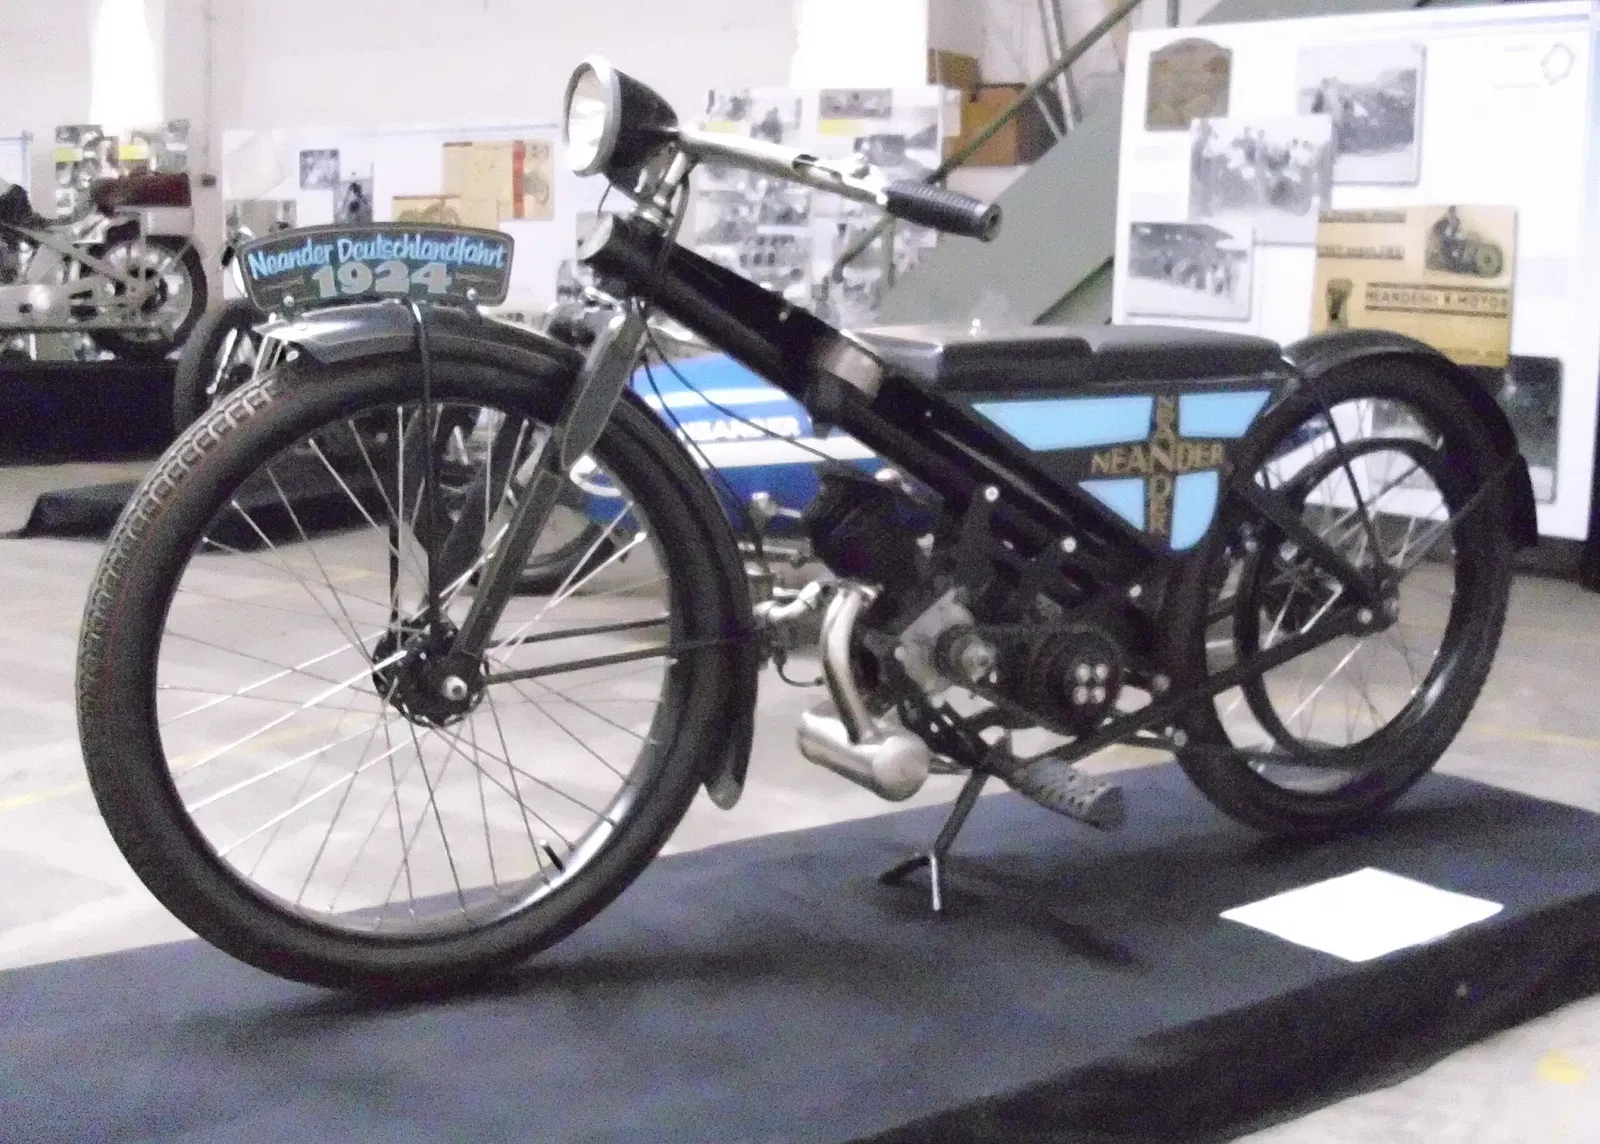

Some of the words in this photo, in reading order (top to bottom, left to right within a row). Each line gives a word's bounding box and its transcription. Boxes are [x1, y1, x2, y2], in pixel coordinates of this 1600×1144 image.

[248, 237, 333, 279] Neander
[337, 233, 504, 268] Deutschlandfahrt
[311, 260, 450, 298] 1924
[1090, 441, 1225, 476] NEANDER
